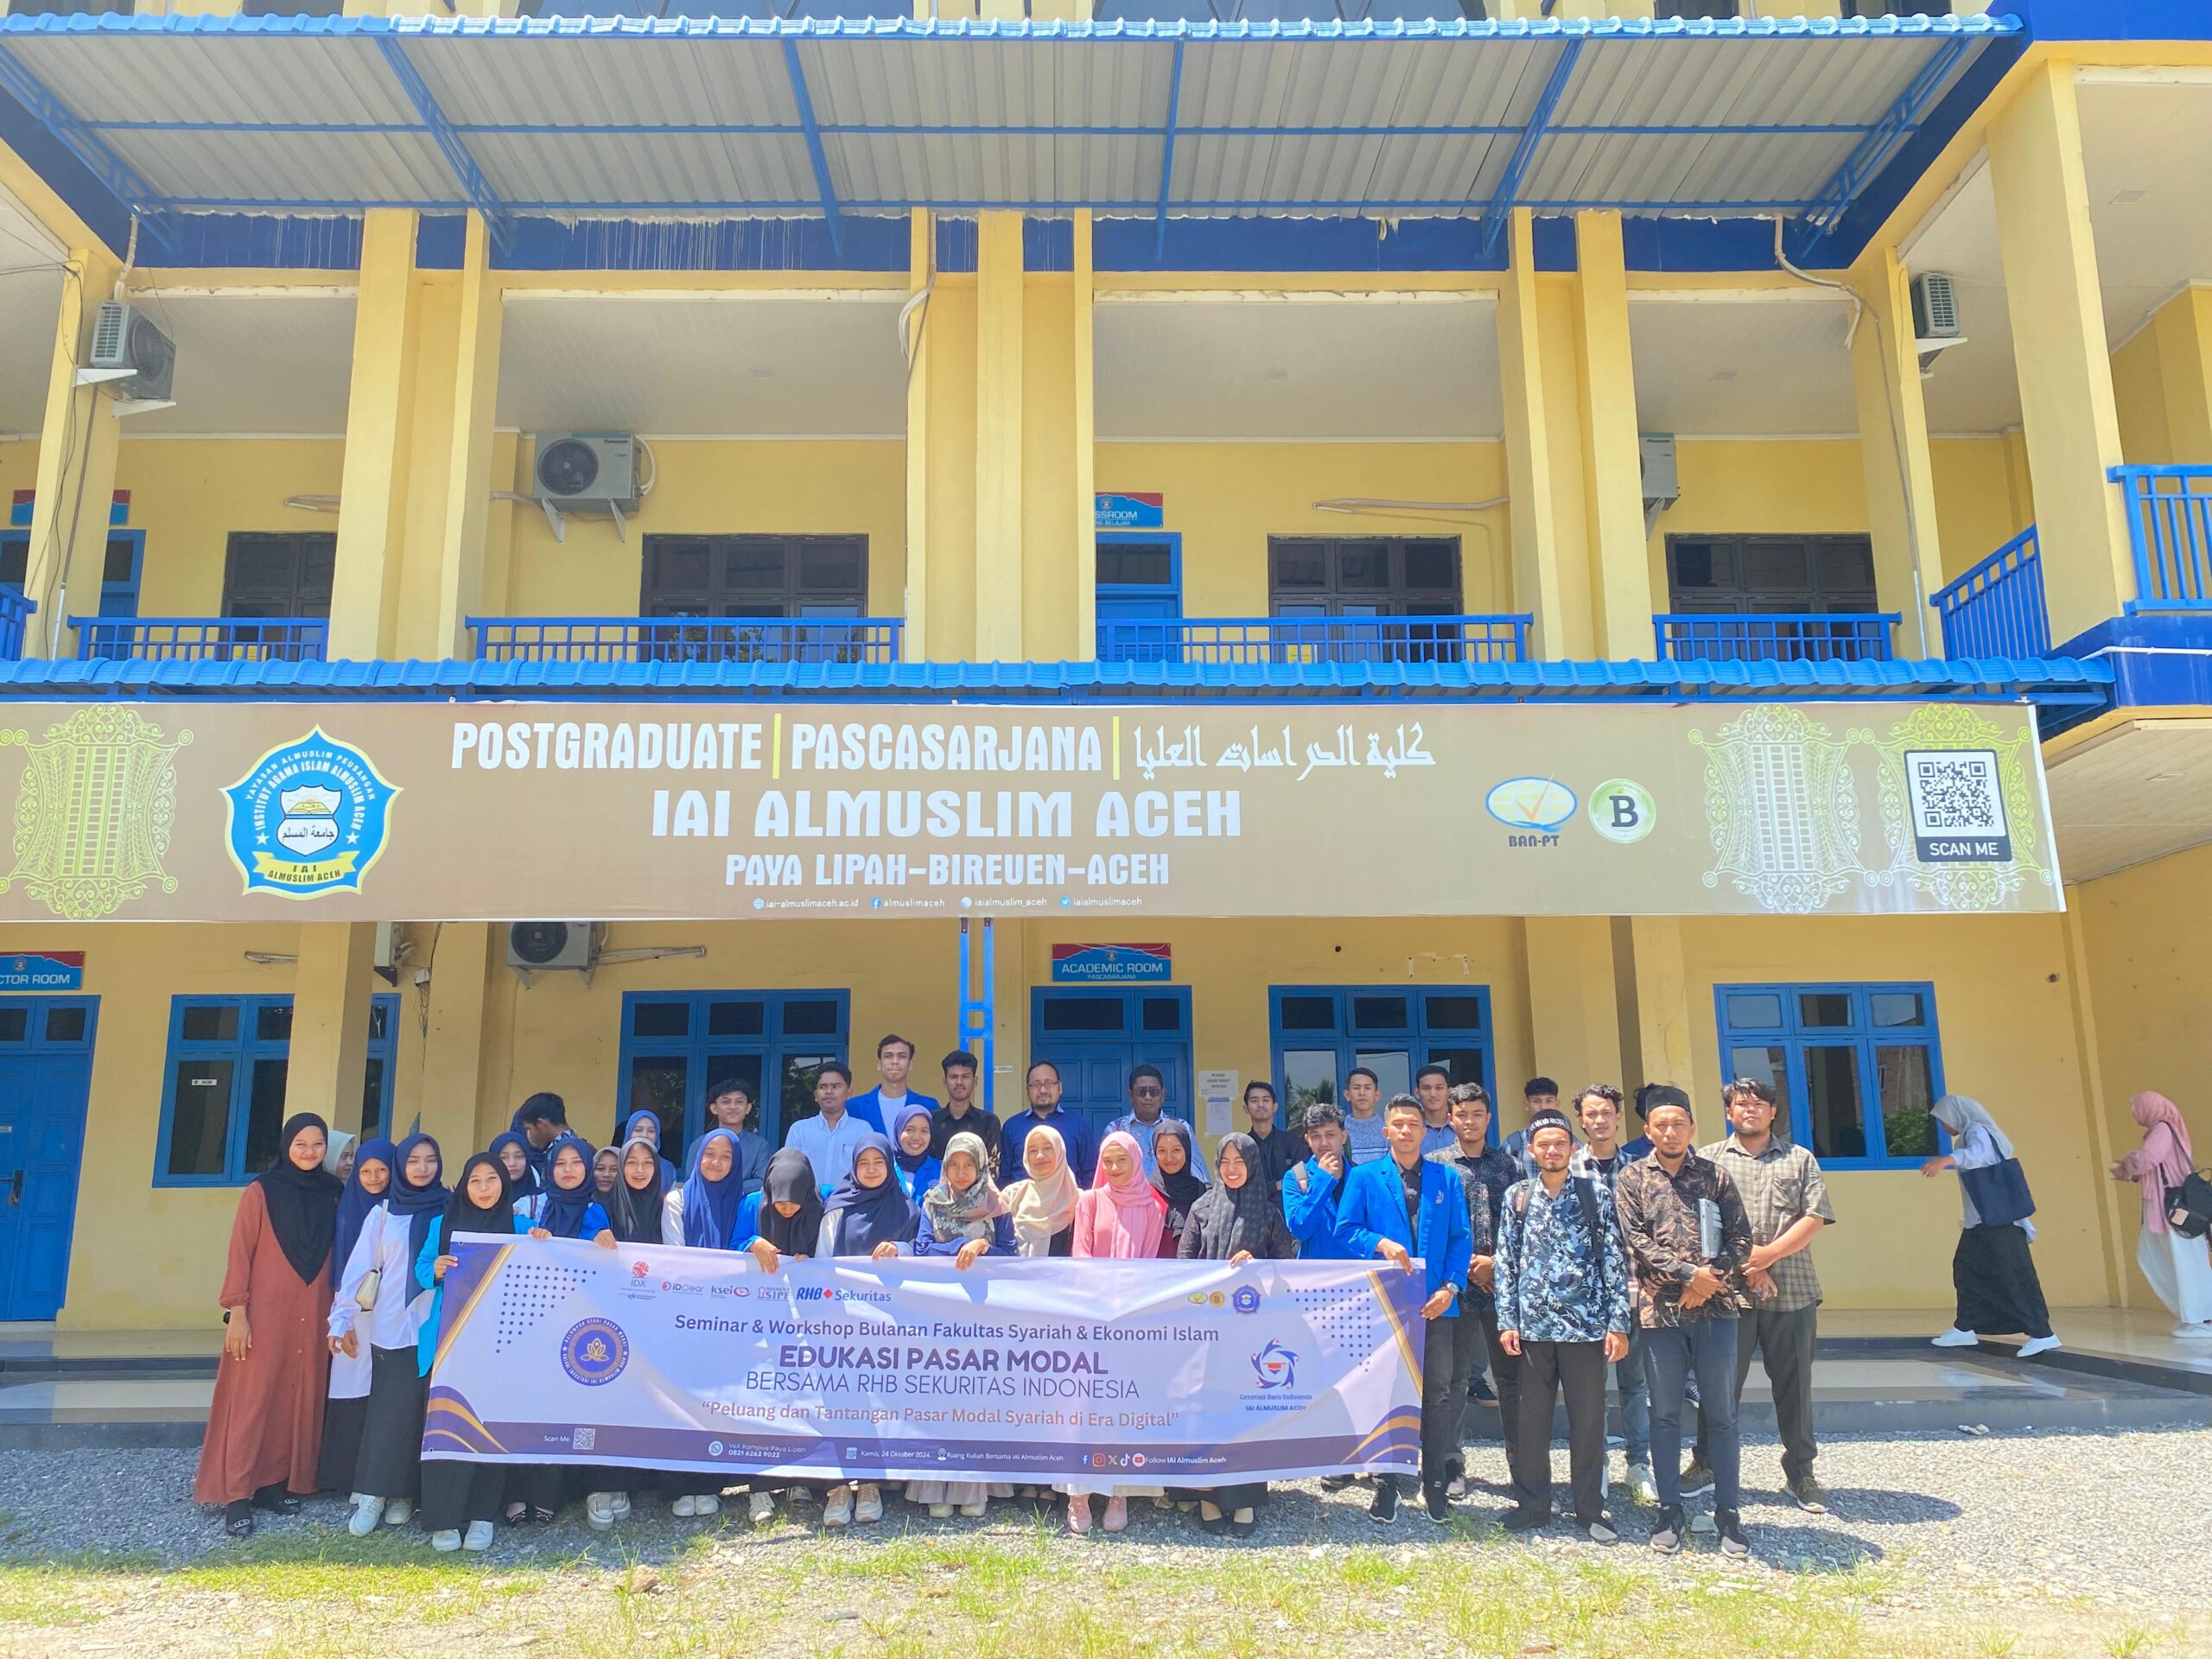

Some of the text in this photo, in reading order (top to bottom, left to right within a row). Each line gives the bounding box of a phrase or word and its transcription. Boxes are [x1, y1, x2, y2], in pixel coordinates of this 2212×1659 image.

[1095, 511, 1138, 519] SSROOM
[451, 722, 1102, 772] POSTGRADUATE PASCASARJANA
[1134, 724, 1207, 780] العليا
[1366, 721, 1436, 779] كلية
[245, 750, 377, 800] YAYASAN ALMUSLIM PEUSANGAN
[253, 760, 365, 831] INSTITUT AGAMA ISLAM ALMUSLIM ACEH
[652, 791, 1241, 837] IAI ALMUSLIM ACEH
[1609, 795, 1638, 827] B
[1509, 835, 1560, 847] BAN-PT
[1929, 842, 1999, 855] SCAN ME
[268, 869, 341, 882] ALMUSLIM ACEH
[726, 854, 1169, 885] PAYA LIPAH-BIREUEN-ACEH
[883, 899, 945, 907] almuslimaceh
[0, 974, 70, 984] CTOR ROOM
[1061, 963, 1163, 973] ACADEMIC ROOM
[631, 1279, 646, 1287] IDX
[711, 1285, 734, 1294] ksei
[796, 1287, 891, 1301] RHB Sekuritas
[675, 1314, 1219, 1342] Seminar & Workshop Bulanan Fakultas Syariah & Ekonomi Islam
[779, 1345, 1109, 1375] EDUKASI PASAR MODAL
[747, 1371, 1140, 1399] BERSAMA RHB SEKURITAS INDONESIA
[702, 1402, 1179, 1430] “Peluang dan Tantangan Pasar Modal Syariah di Era Digital”
[946, 1452, 965, 1460] Ruang
